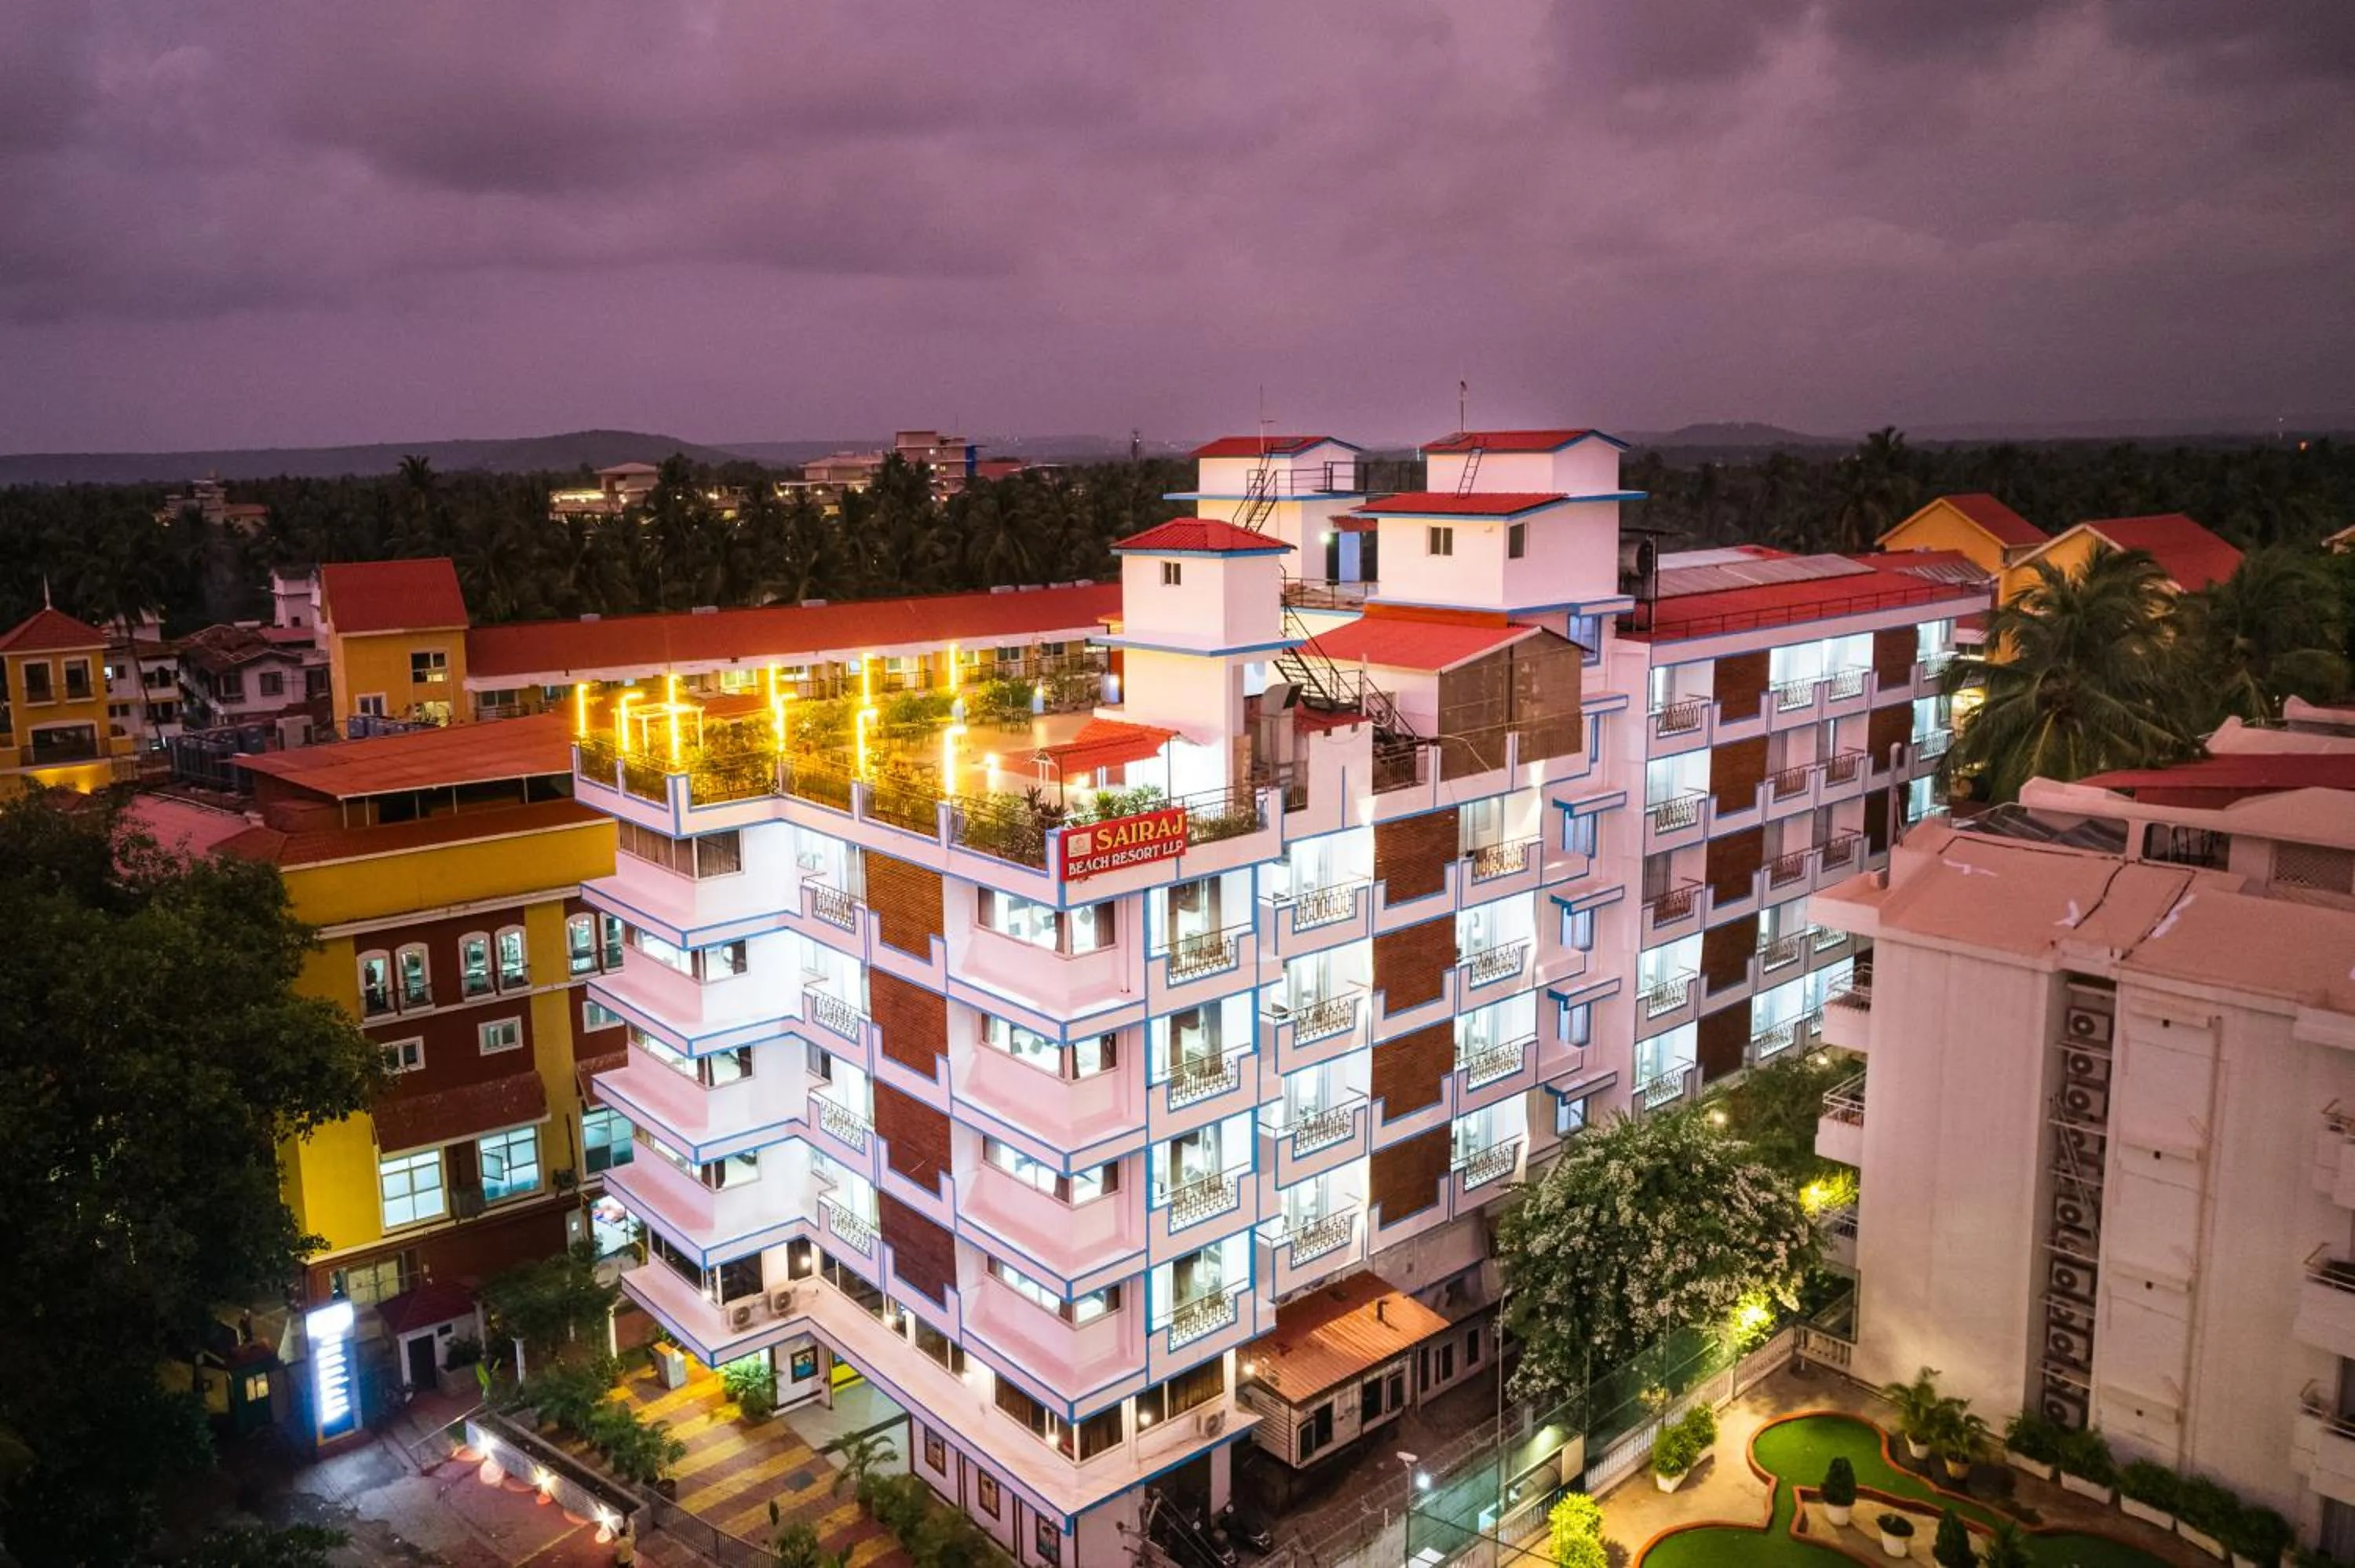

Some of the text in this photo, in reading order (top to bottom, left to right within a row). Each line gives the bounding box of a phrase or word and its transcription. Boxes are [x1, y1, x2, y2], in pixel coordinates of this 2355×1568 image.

[1096, 814, 1184, 851] SAIRAJ
[1068, 840, 1183, 876] BEACH RESORT LLP
